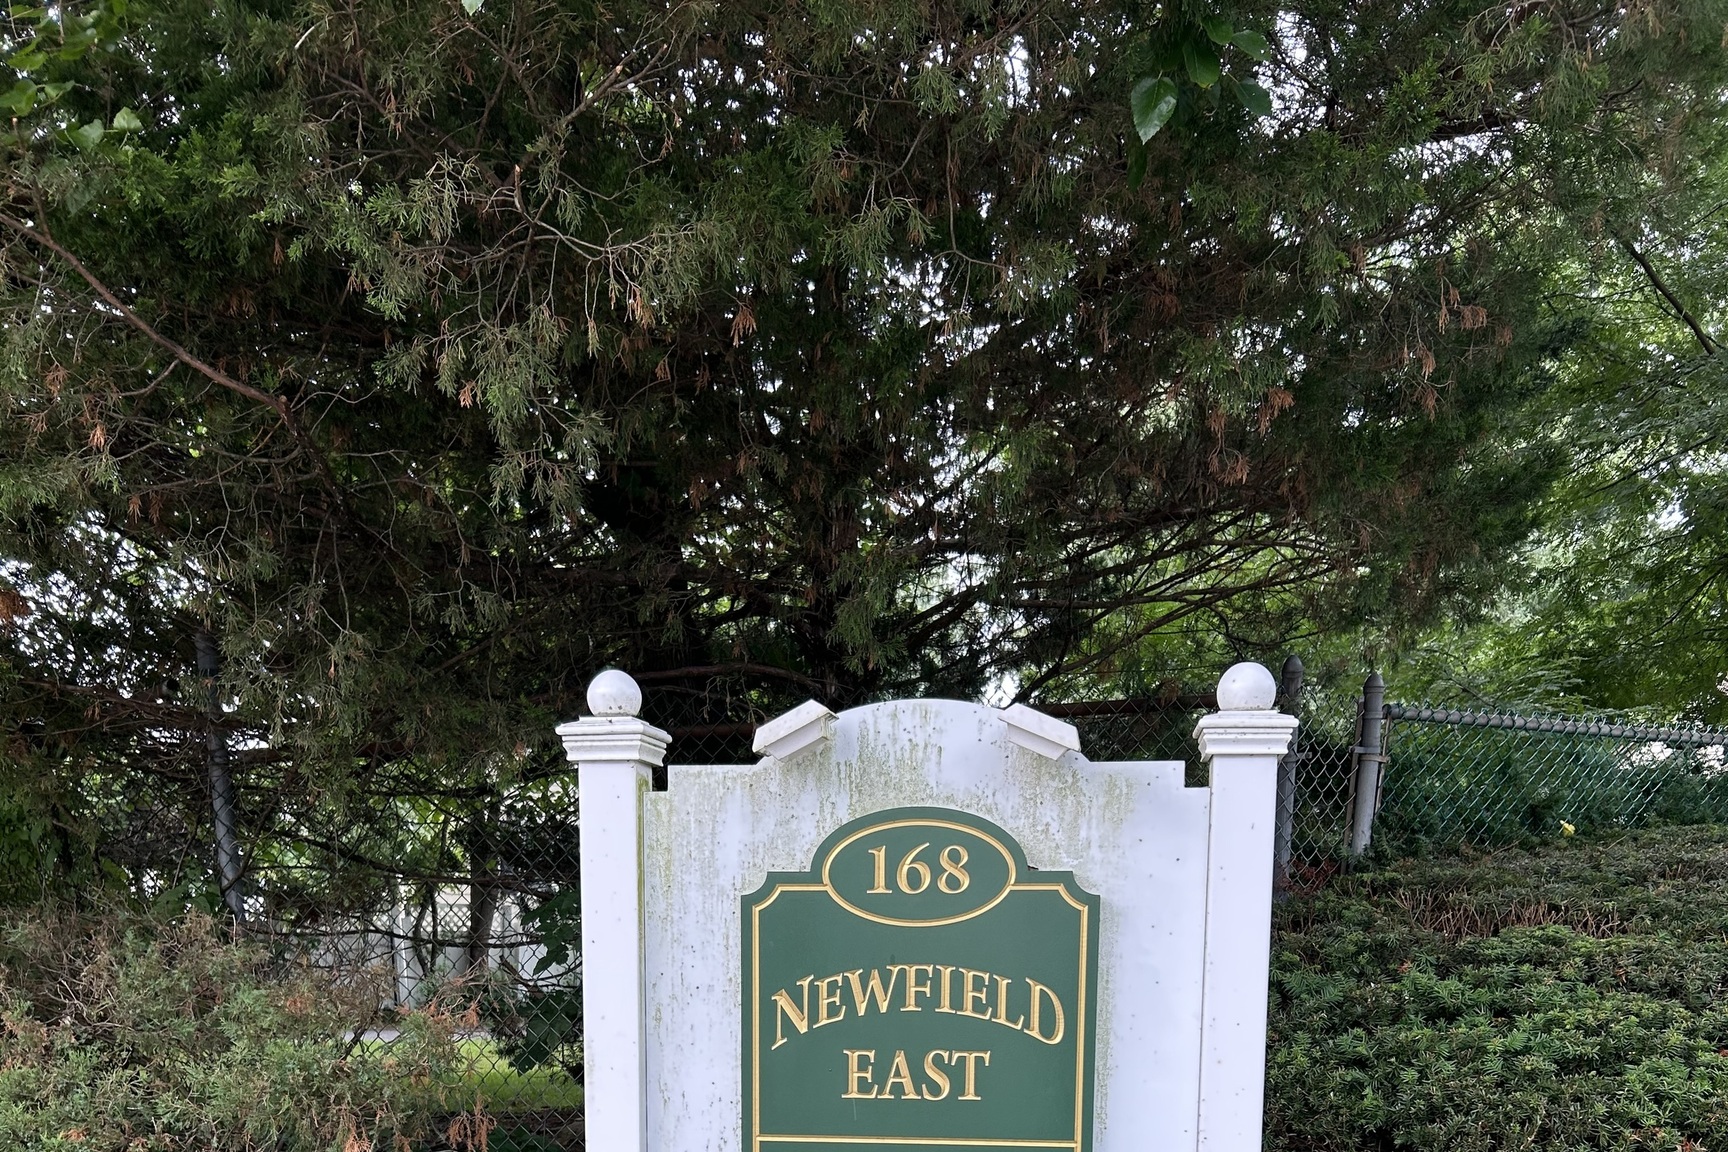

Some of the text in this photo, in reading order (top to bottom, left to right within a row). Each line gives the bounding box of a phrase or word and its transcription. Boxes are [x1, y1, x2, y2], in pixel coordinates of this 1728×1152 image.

[867, 842, 970, 894] 168
[771, 963, 1065, 1050] NEWFIELD
[841, 1048, 991, 1101] EAST
